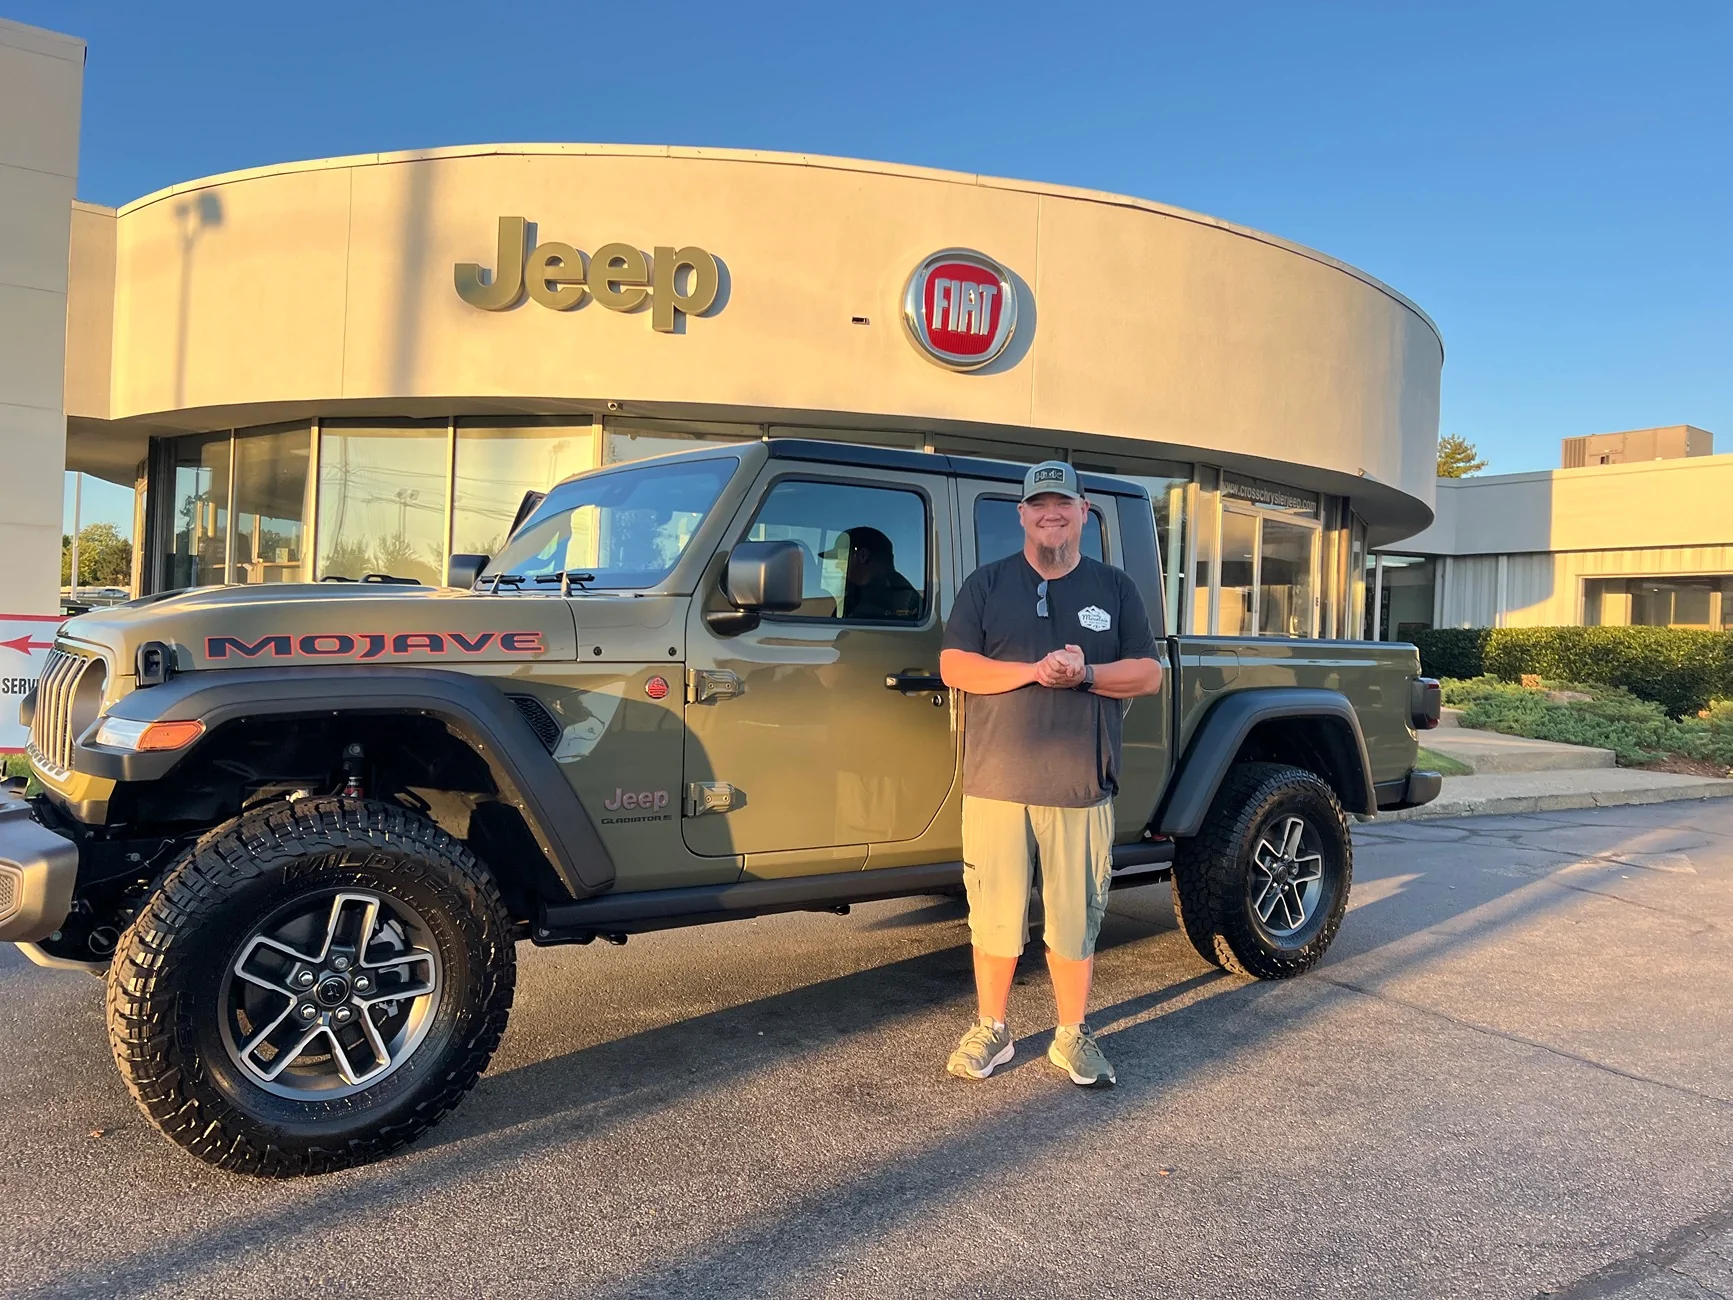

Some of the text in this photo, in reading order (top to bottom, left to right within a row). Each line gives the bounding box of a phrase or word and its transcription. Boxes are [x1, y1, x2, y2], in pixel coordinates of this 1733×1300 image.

[454, 216, 720, 332] Jeep
[931, 278, 998, 336] FIAT
[205, 632, 544, 660] MOJAVE
[604, 787, 669, 813] Jeep
[601, 815, 662, 825] GLADIATOR
